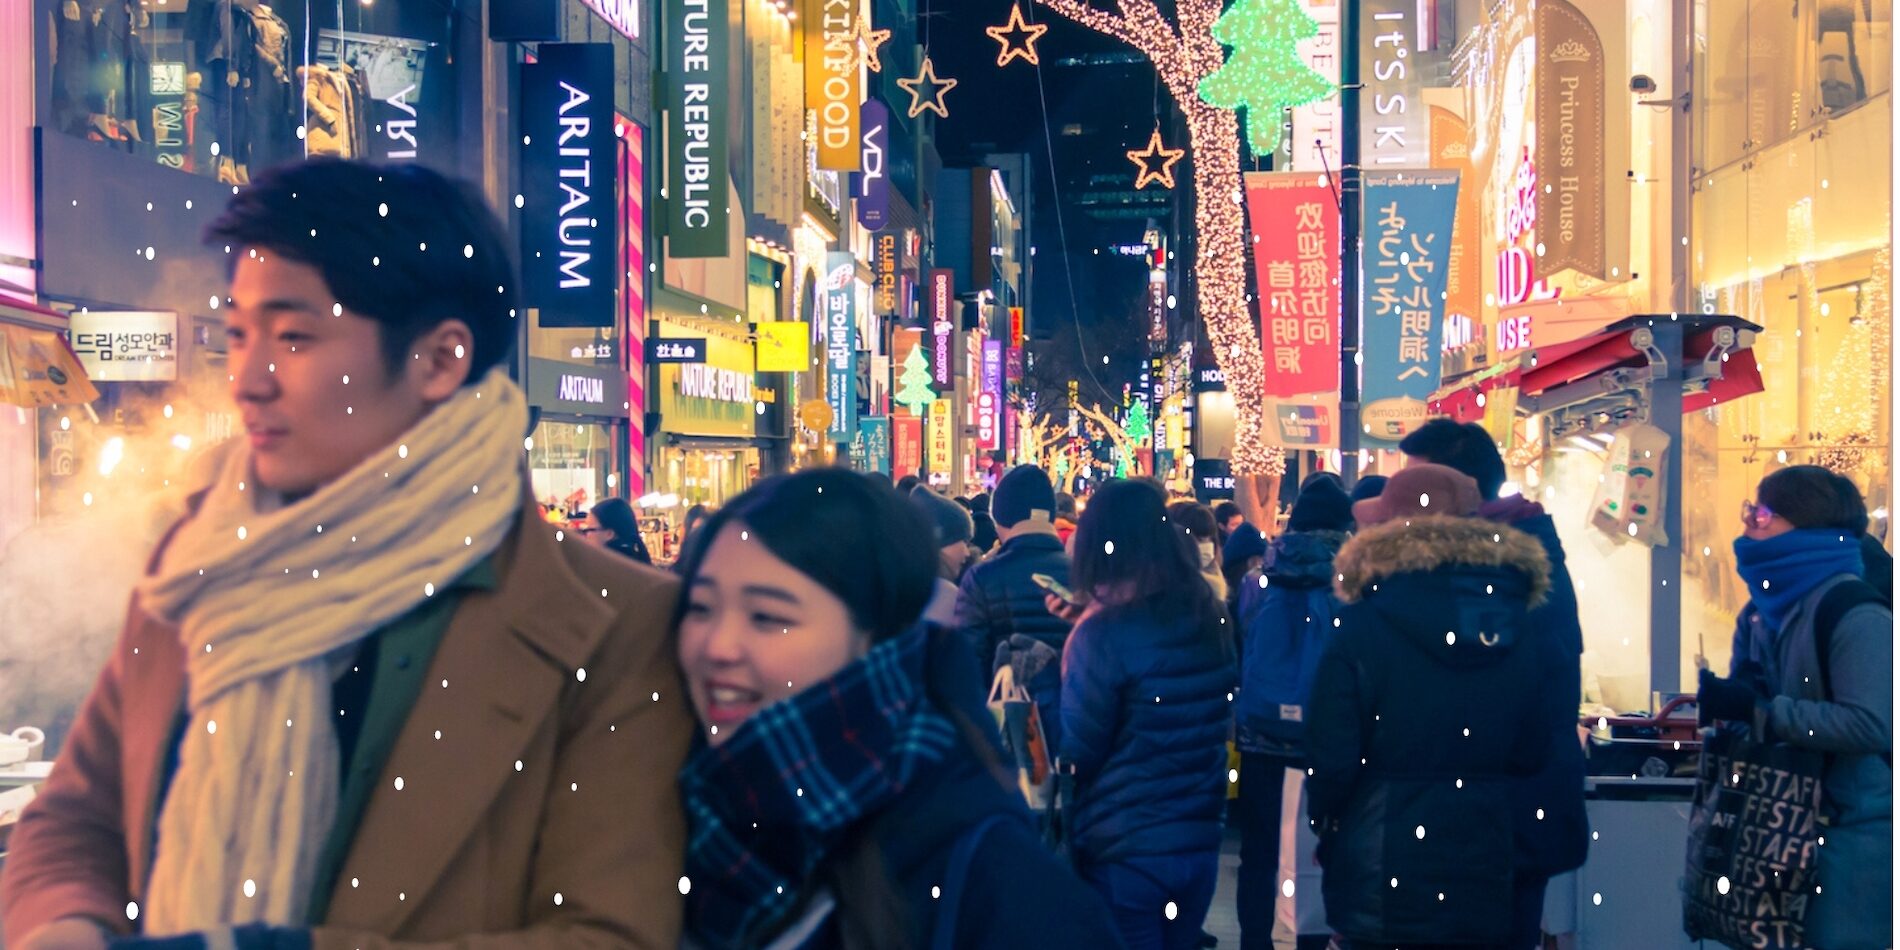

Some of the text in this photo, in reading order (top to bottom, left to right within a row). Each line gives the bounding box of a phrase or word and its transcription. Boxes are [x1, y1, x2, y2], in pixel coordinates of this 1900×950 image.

[684, 0, 709, 228] TURE REPUBLIC
[559, 80, 591, 288] ARITAUM
[863, 125, 882, 196] VDL
[1560, 75, 1580, 244] Princess House
[1450, 244, 1463, 294] House
[75, 332, 174, 361] 드림 성모안과
[1497, 315, 1532, 352] USE
[681, 362, 717, 400] NATURE
[717, 368, 755, 404] REPUBLIC
[936, 335, 949, 384] DONUTS
[559, 373, 604, 404] ARITAUM
[1204, 478, 1223, 489] THE
